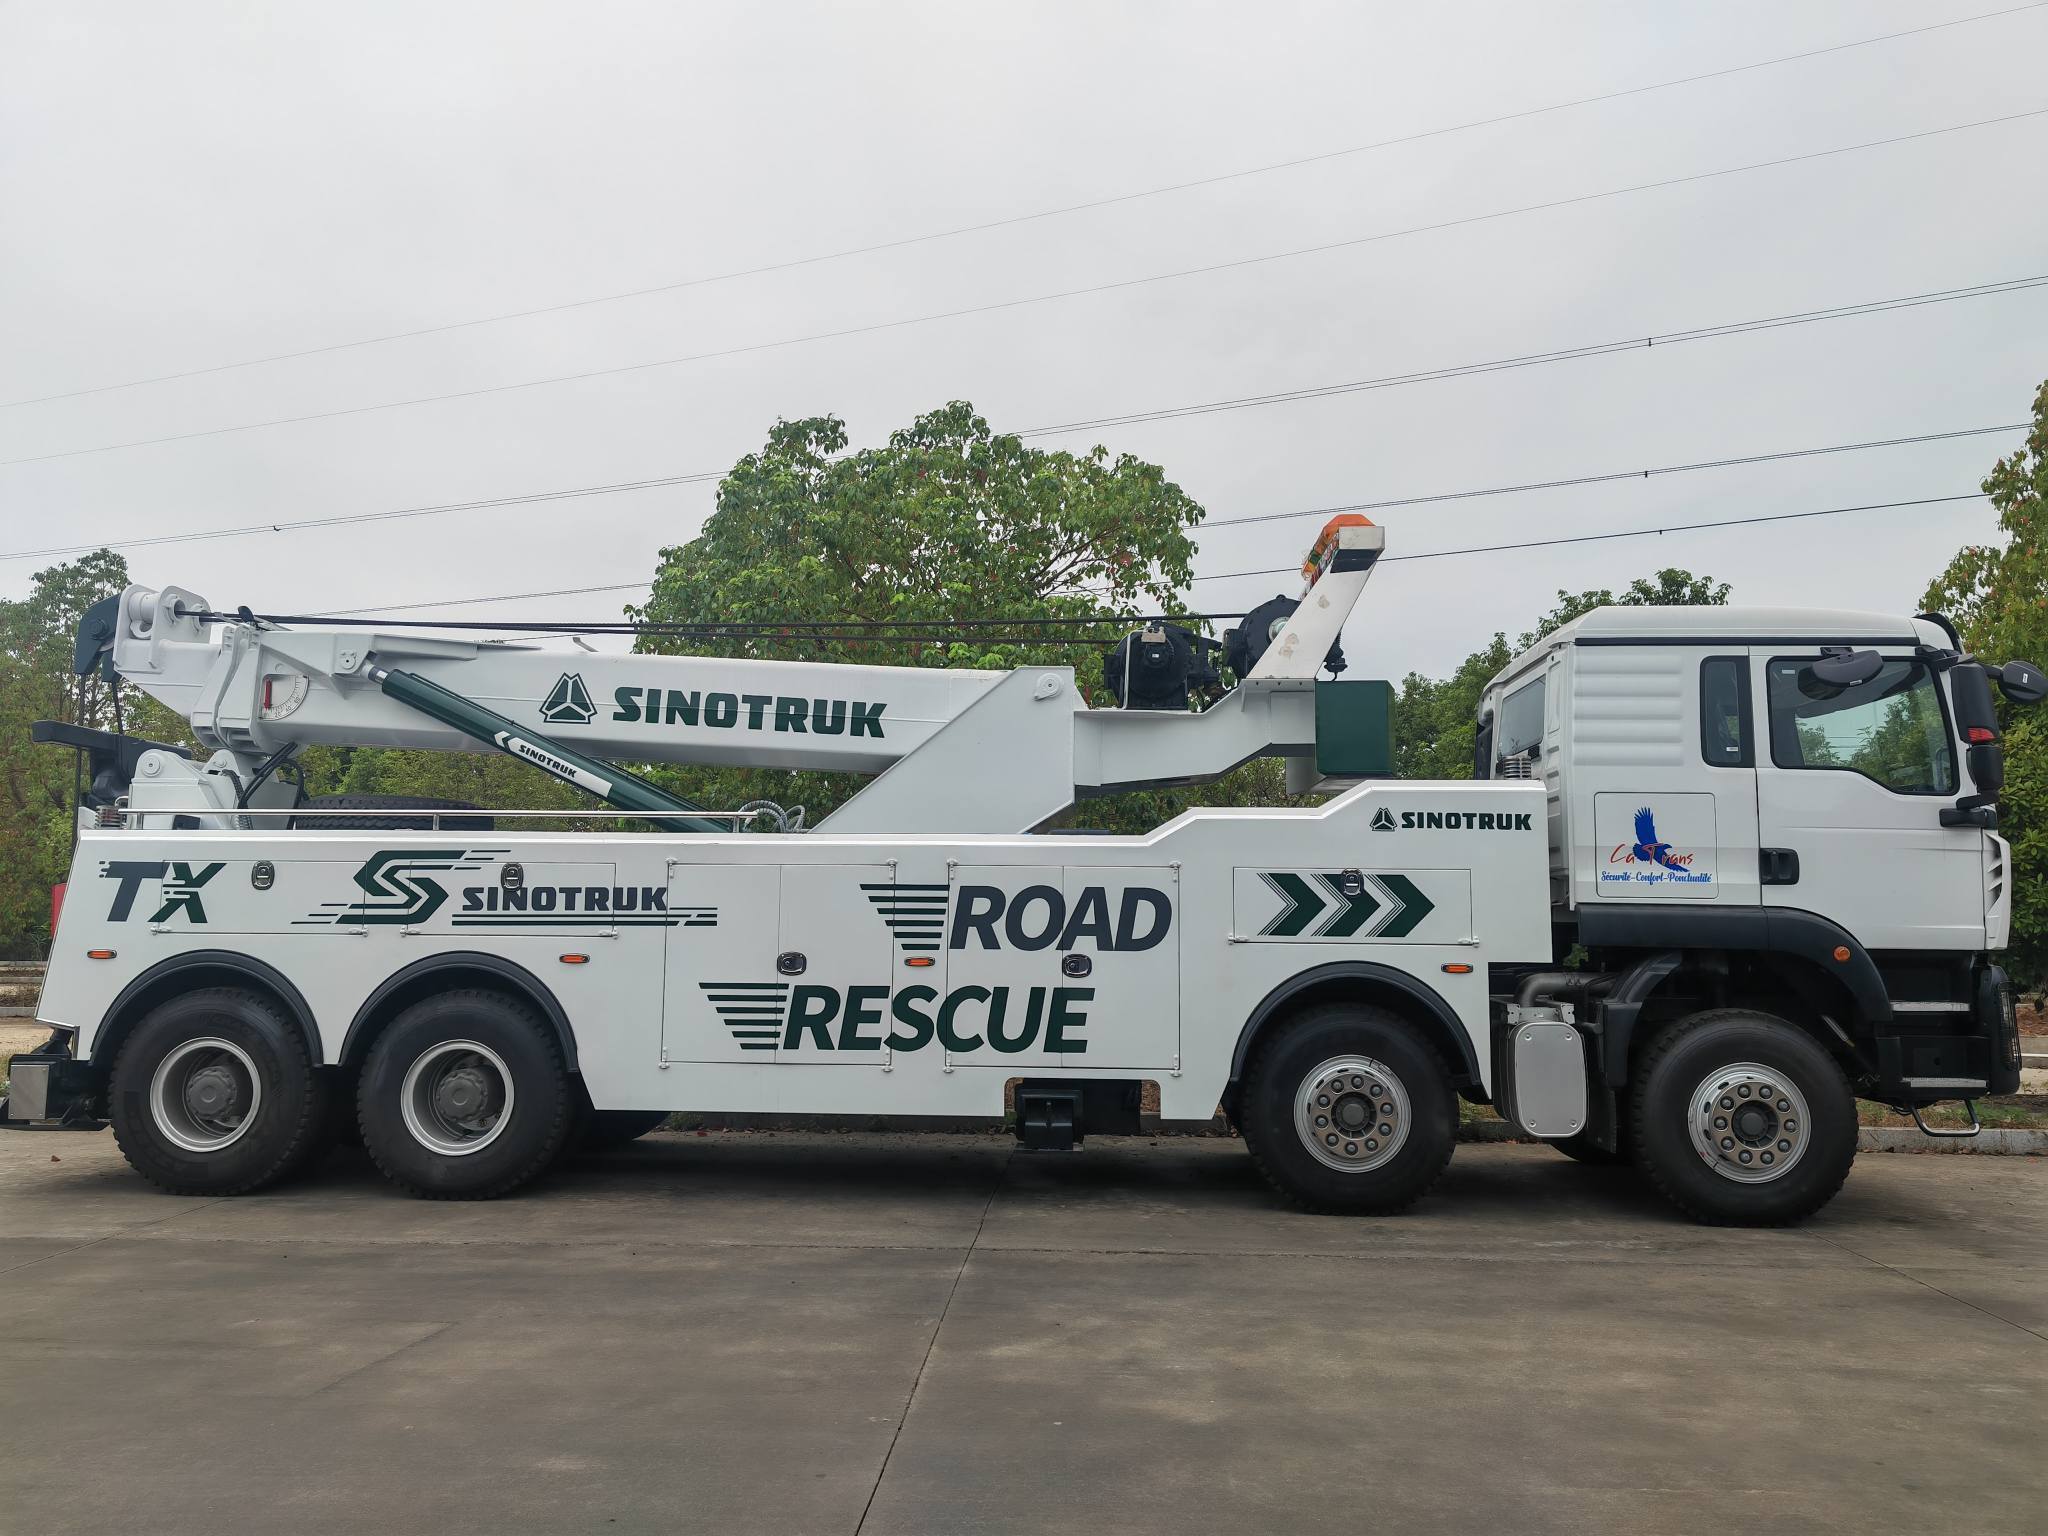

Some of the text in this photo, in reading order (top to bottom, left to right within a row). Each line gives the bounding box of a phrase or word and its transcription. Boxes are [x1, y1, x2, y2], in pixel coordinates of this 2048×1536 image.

[612, 686, 888, 739] SINOTRUK
[518, 744, 578, 779] SINOTRUK
[1401, 811, 1533, 831] SINOTRUK
[1610, 842, 1694, 865] Ca Trans
[98, 860, 228, 924] TX
[461, 886, 668, 912] SINOTRUK
[948, 884, 1173, 952] ROAD
[782, 984, 1096, 1054] RESCUE
